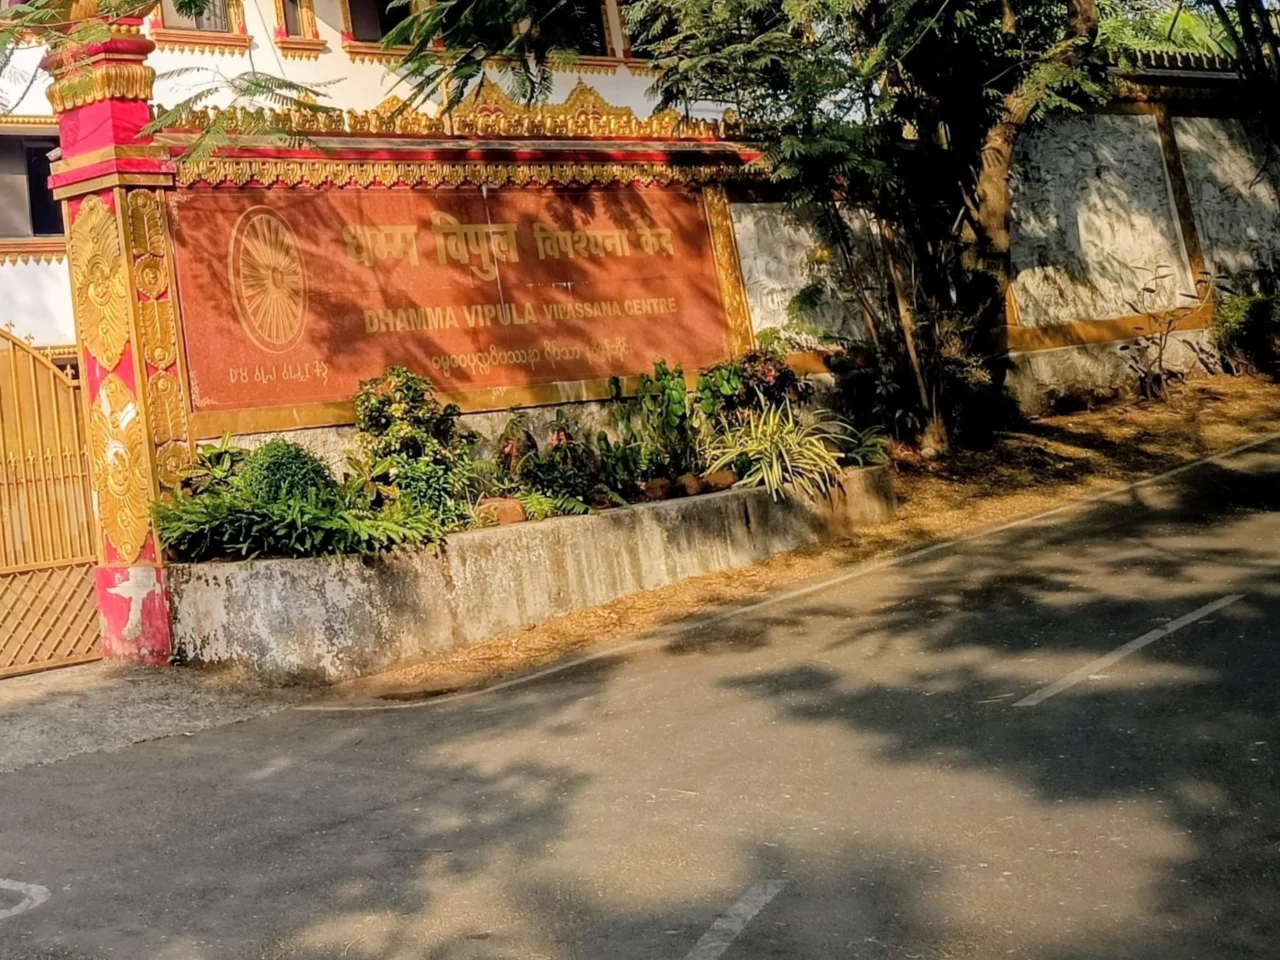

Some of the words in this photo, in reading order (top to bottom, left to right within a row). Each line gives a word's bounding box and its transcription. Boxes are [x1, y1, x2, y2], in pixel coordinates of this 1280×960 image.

[342, 224, 419, 267] धम्म
[430, 210, 520, 281] विपुल
[532, 222, 630, 260] विपश्यना
[363, 305, 460, 333] DHAMMA
[463, 301, 538, 328] VIPULA
[543, 301, 622, 320] VIPASSANA
[624, 297, 677, 315] CENTRE
